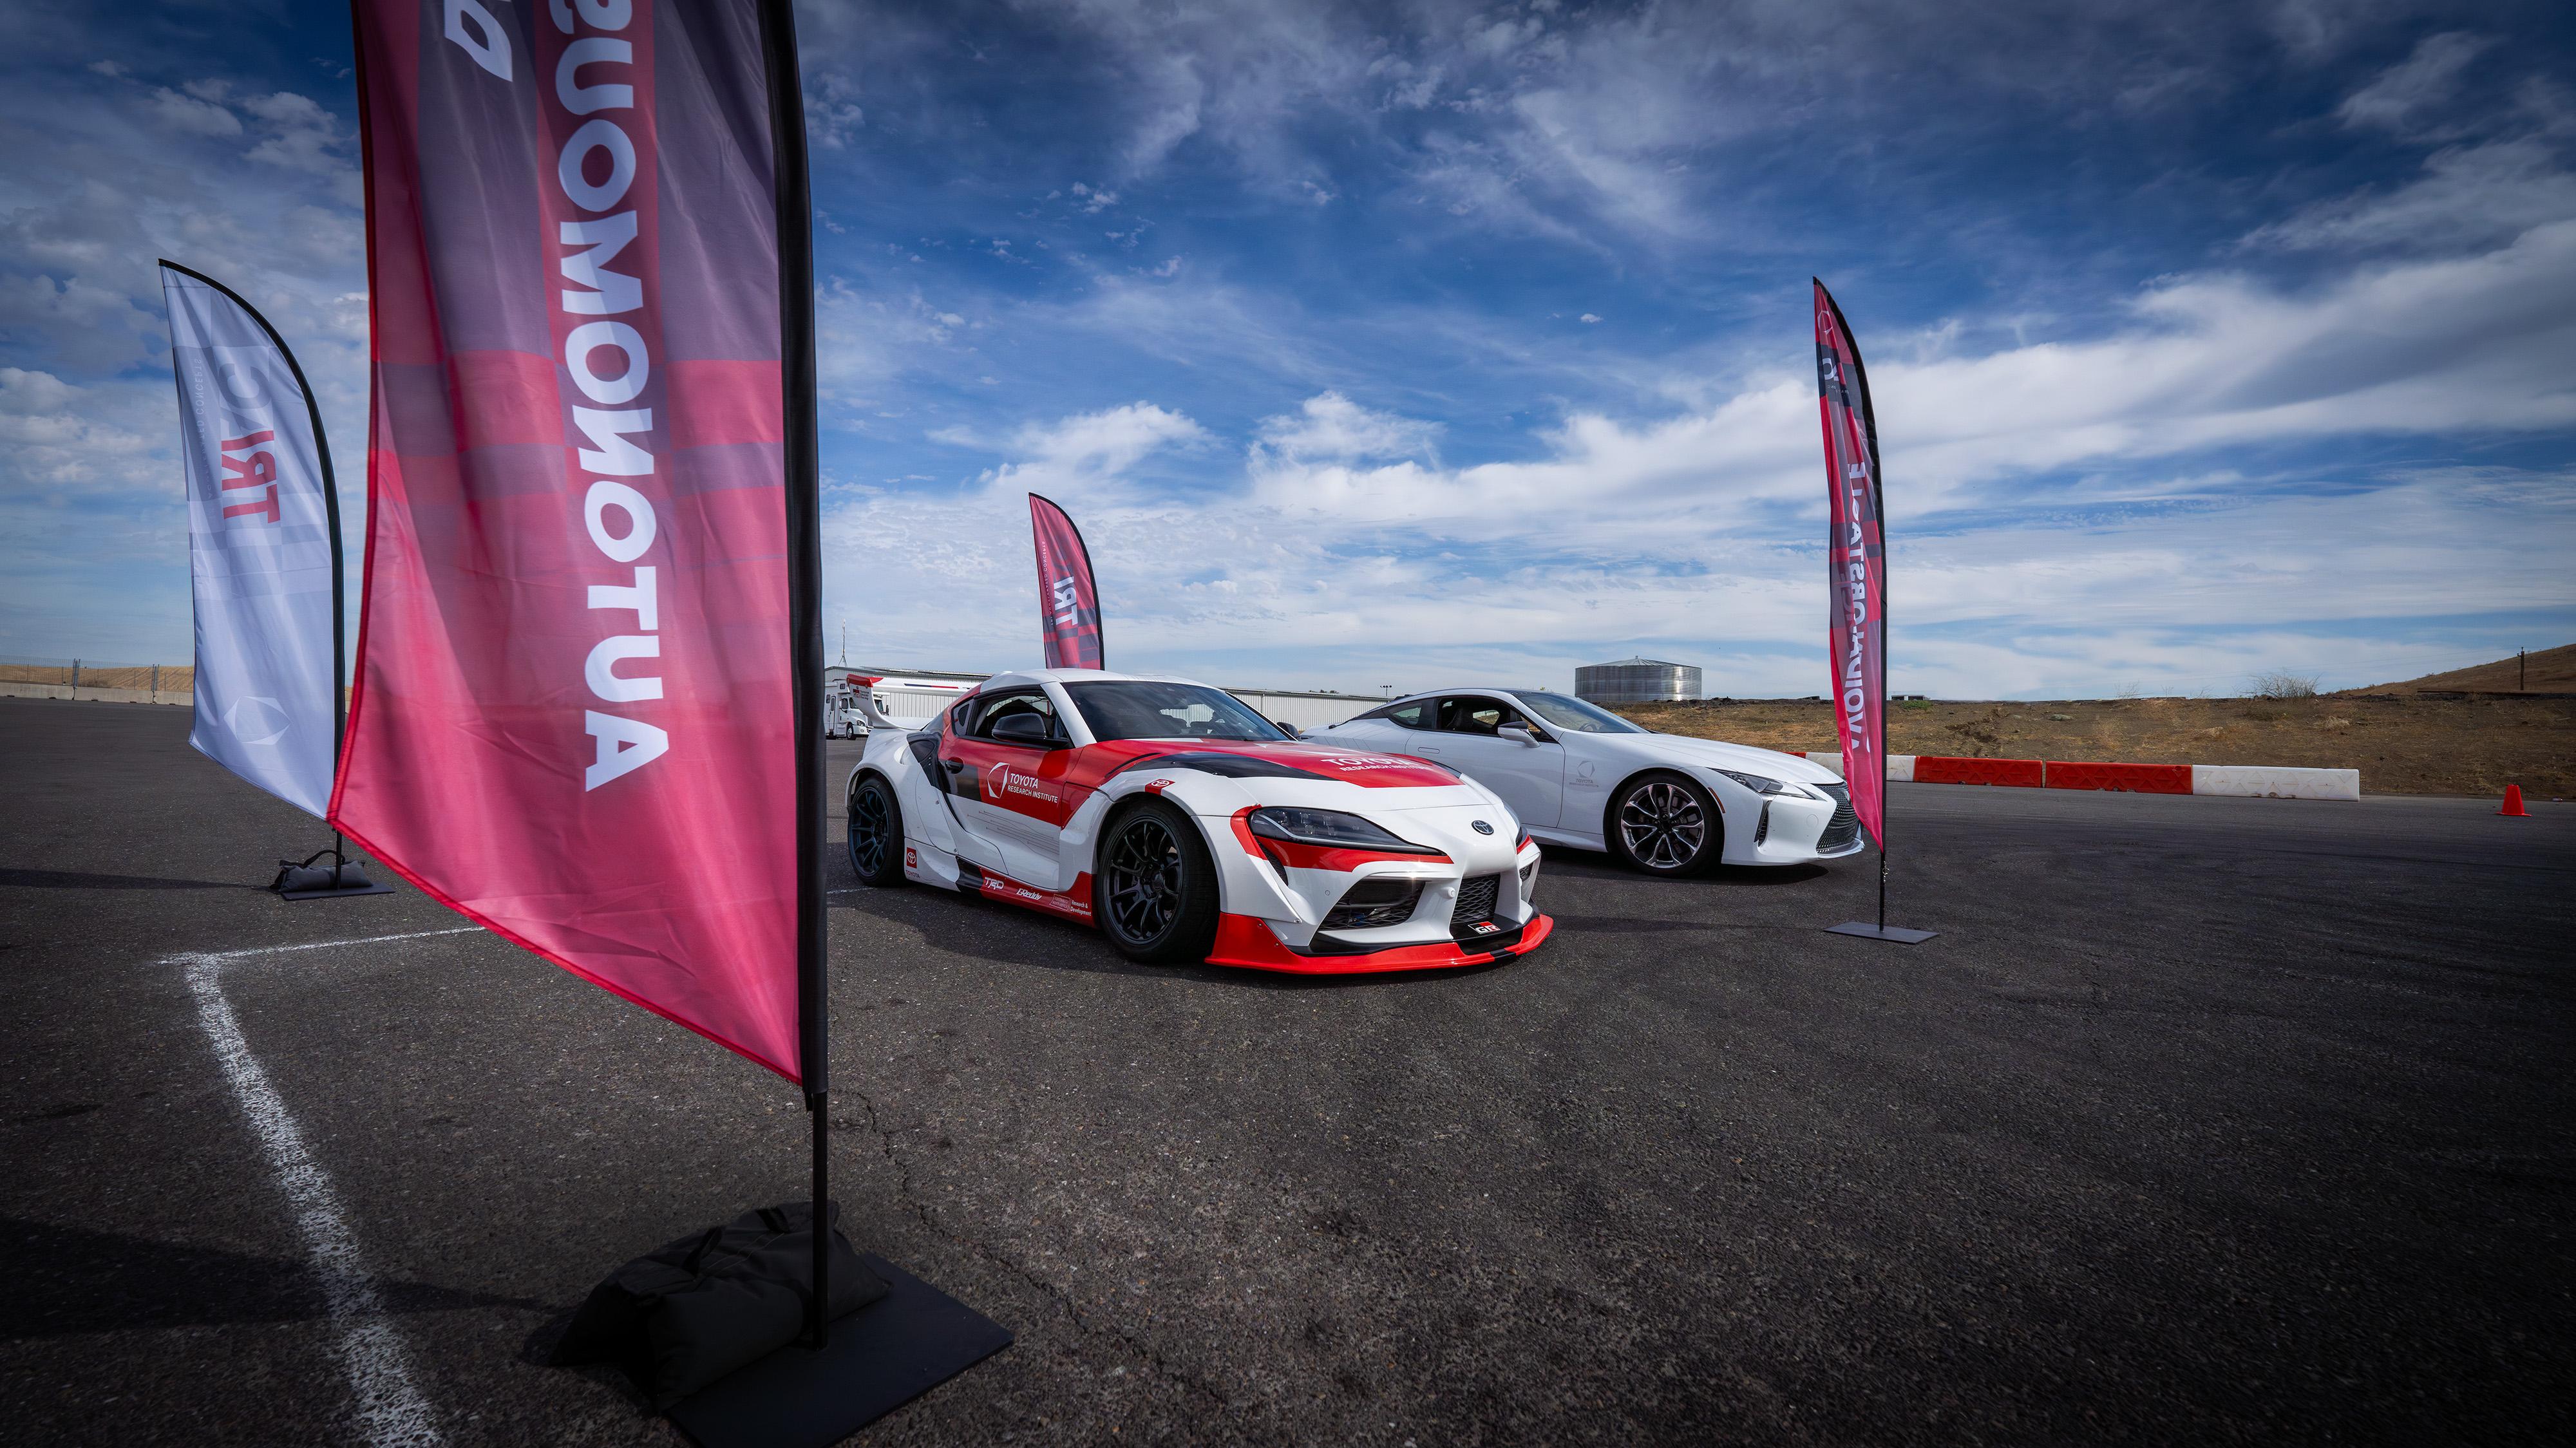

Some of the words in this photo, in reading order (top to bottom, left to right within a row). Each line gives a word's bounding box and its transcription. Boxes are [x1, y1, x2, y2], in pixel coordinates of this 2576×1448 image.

[1321, 758, 1420, 767] TOYOTA
[1010, 773, 1039, 789] TOYOTA
[1007, 785, 1032, 797] RESEARCH
[1032, 791, 1058, 803] INSTITUTE
[905, 870, 920, 878] TOYOTA
[984, 877, 1005, 890] TRD
[1071, 899, 1085, 908] Research
[1070, 906, 1092, 916] Development
[1475, 925, 1501, 934] GR
